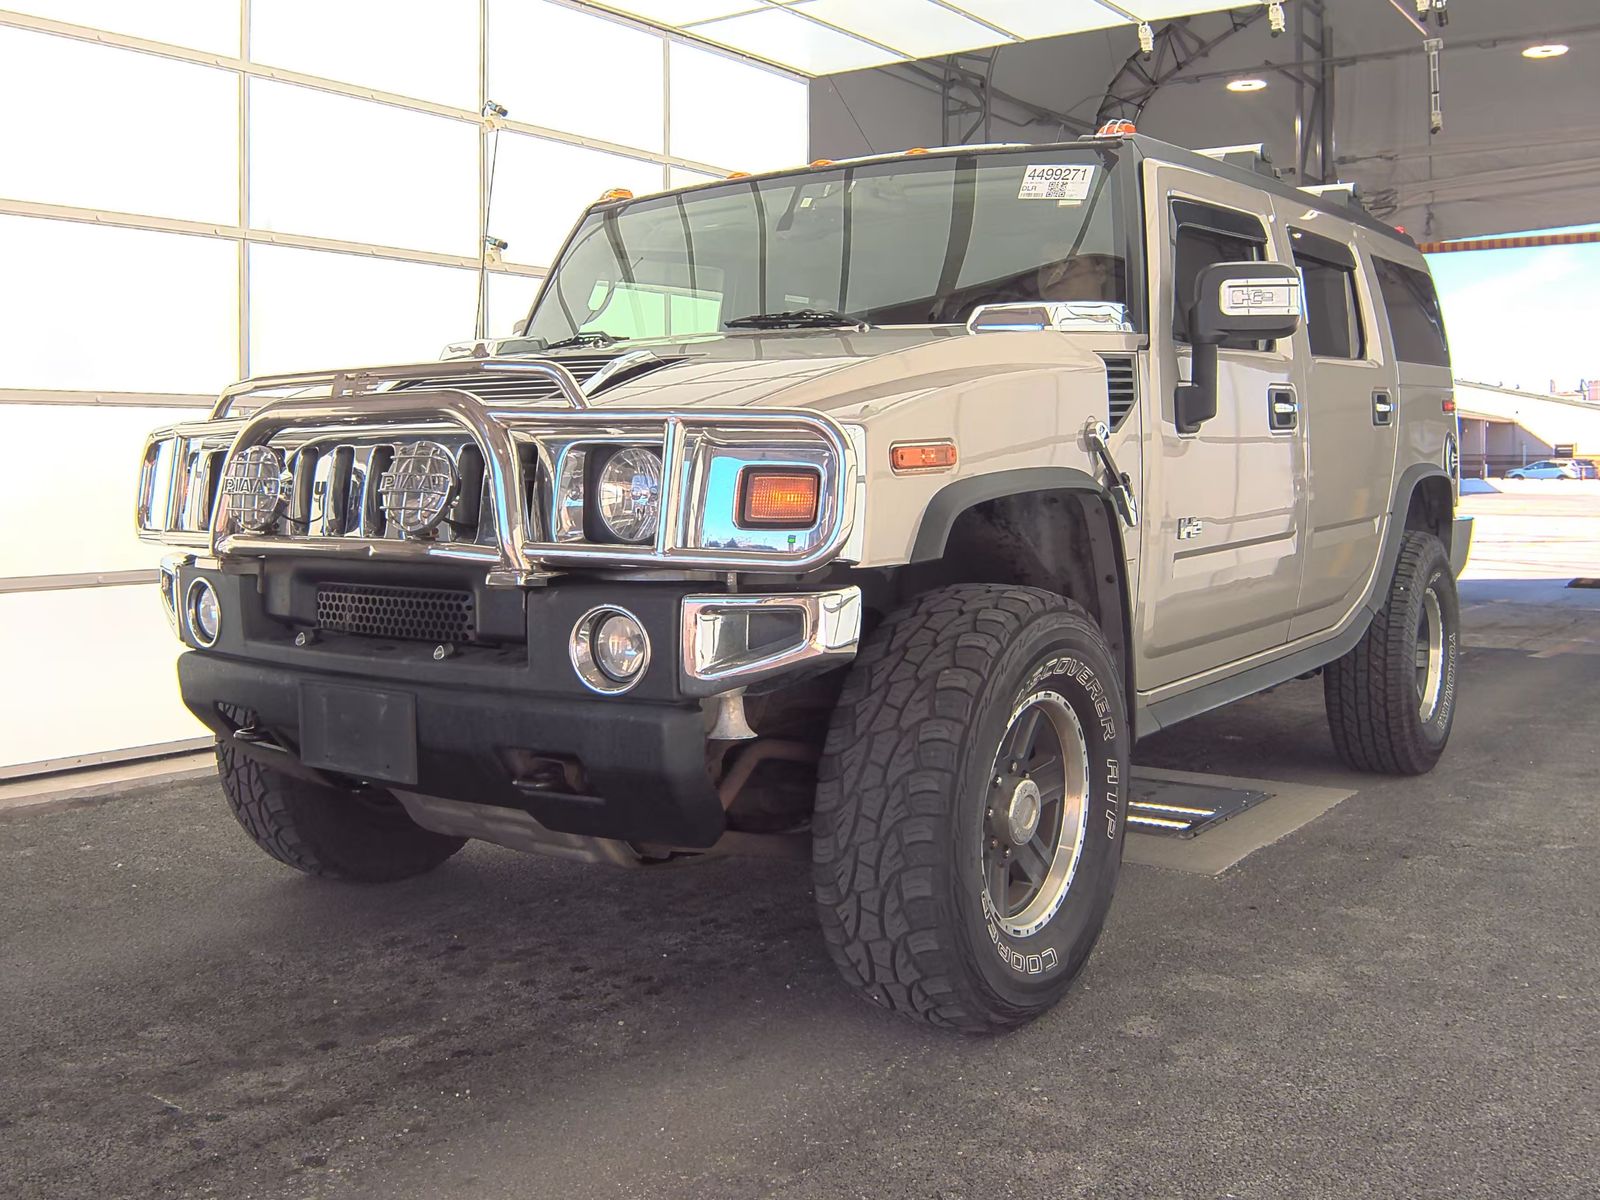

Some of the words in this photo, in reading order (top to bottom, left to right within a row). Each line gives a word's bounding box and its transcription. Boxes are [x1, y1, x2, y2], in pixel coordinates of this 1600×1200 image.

[1028, 168, 1087, 181] 4499271
[382, 474, 434, 491] PIAA
[981, 891, 1058, 974] COOPER
